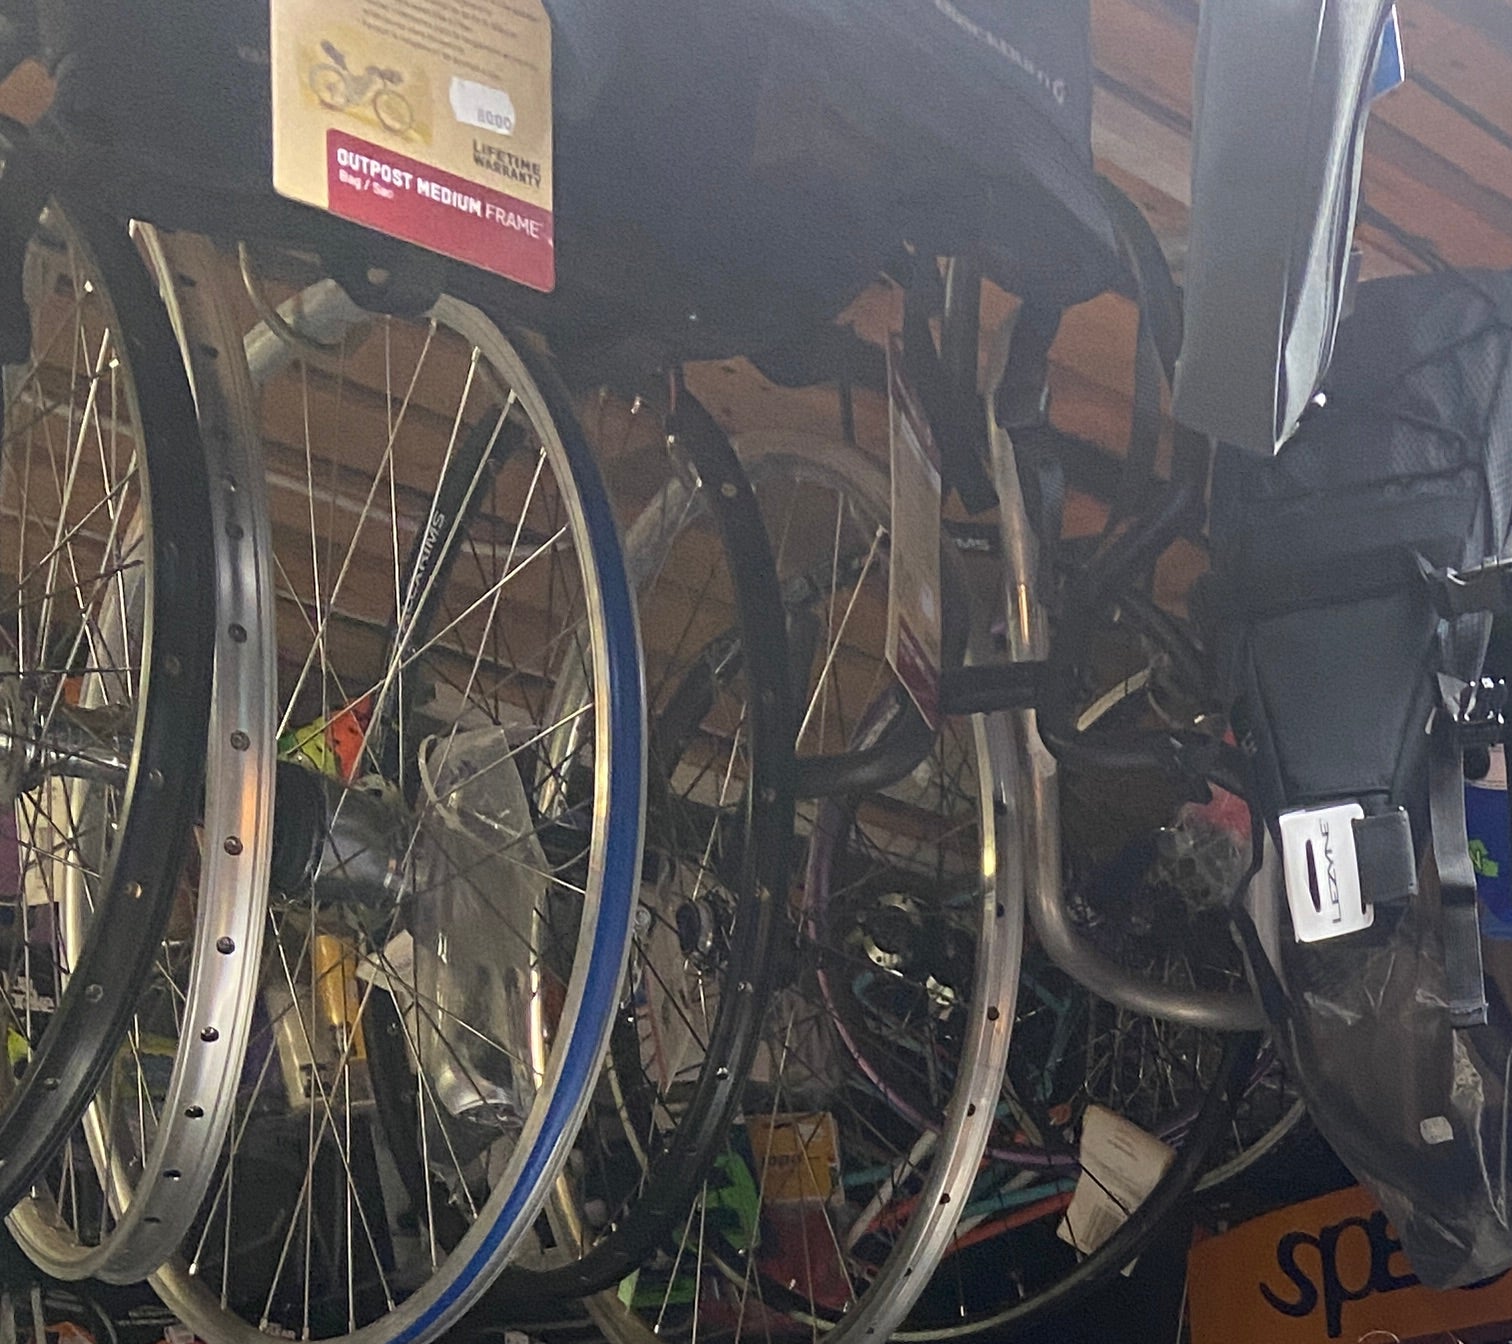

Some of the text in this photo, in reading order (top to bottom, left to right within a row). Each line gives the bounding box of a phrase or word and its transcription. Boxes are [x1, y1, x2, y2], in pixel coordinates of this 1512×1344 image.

[472, 138, 541, 173] LIFETIME
[473, 154, 542, 189] WARRANTY
[336, 147, 542, 240] OUTPOST MEDIUM FRAME
[1319, 818, 1343, 924] LEZYNE
